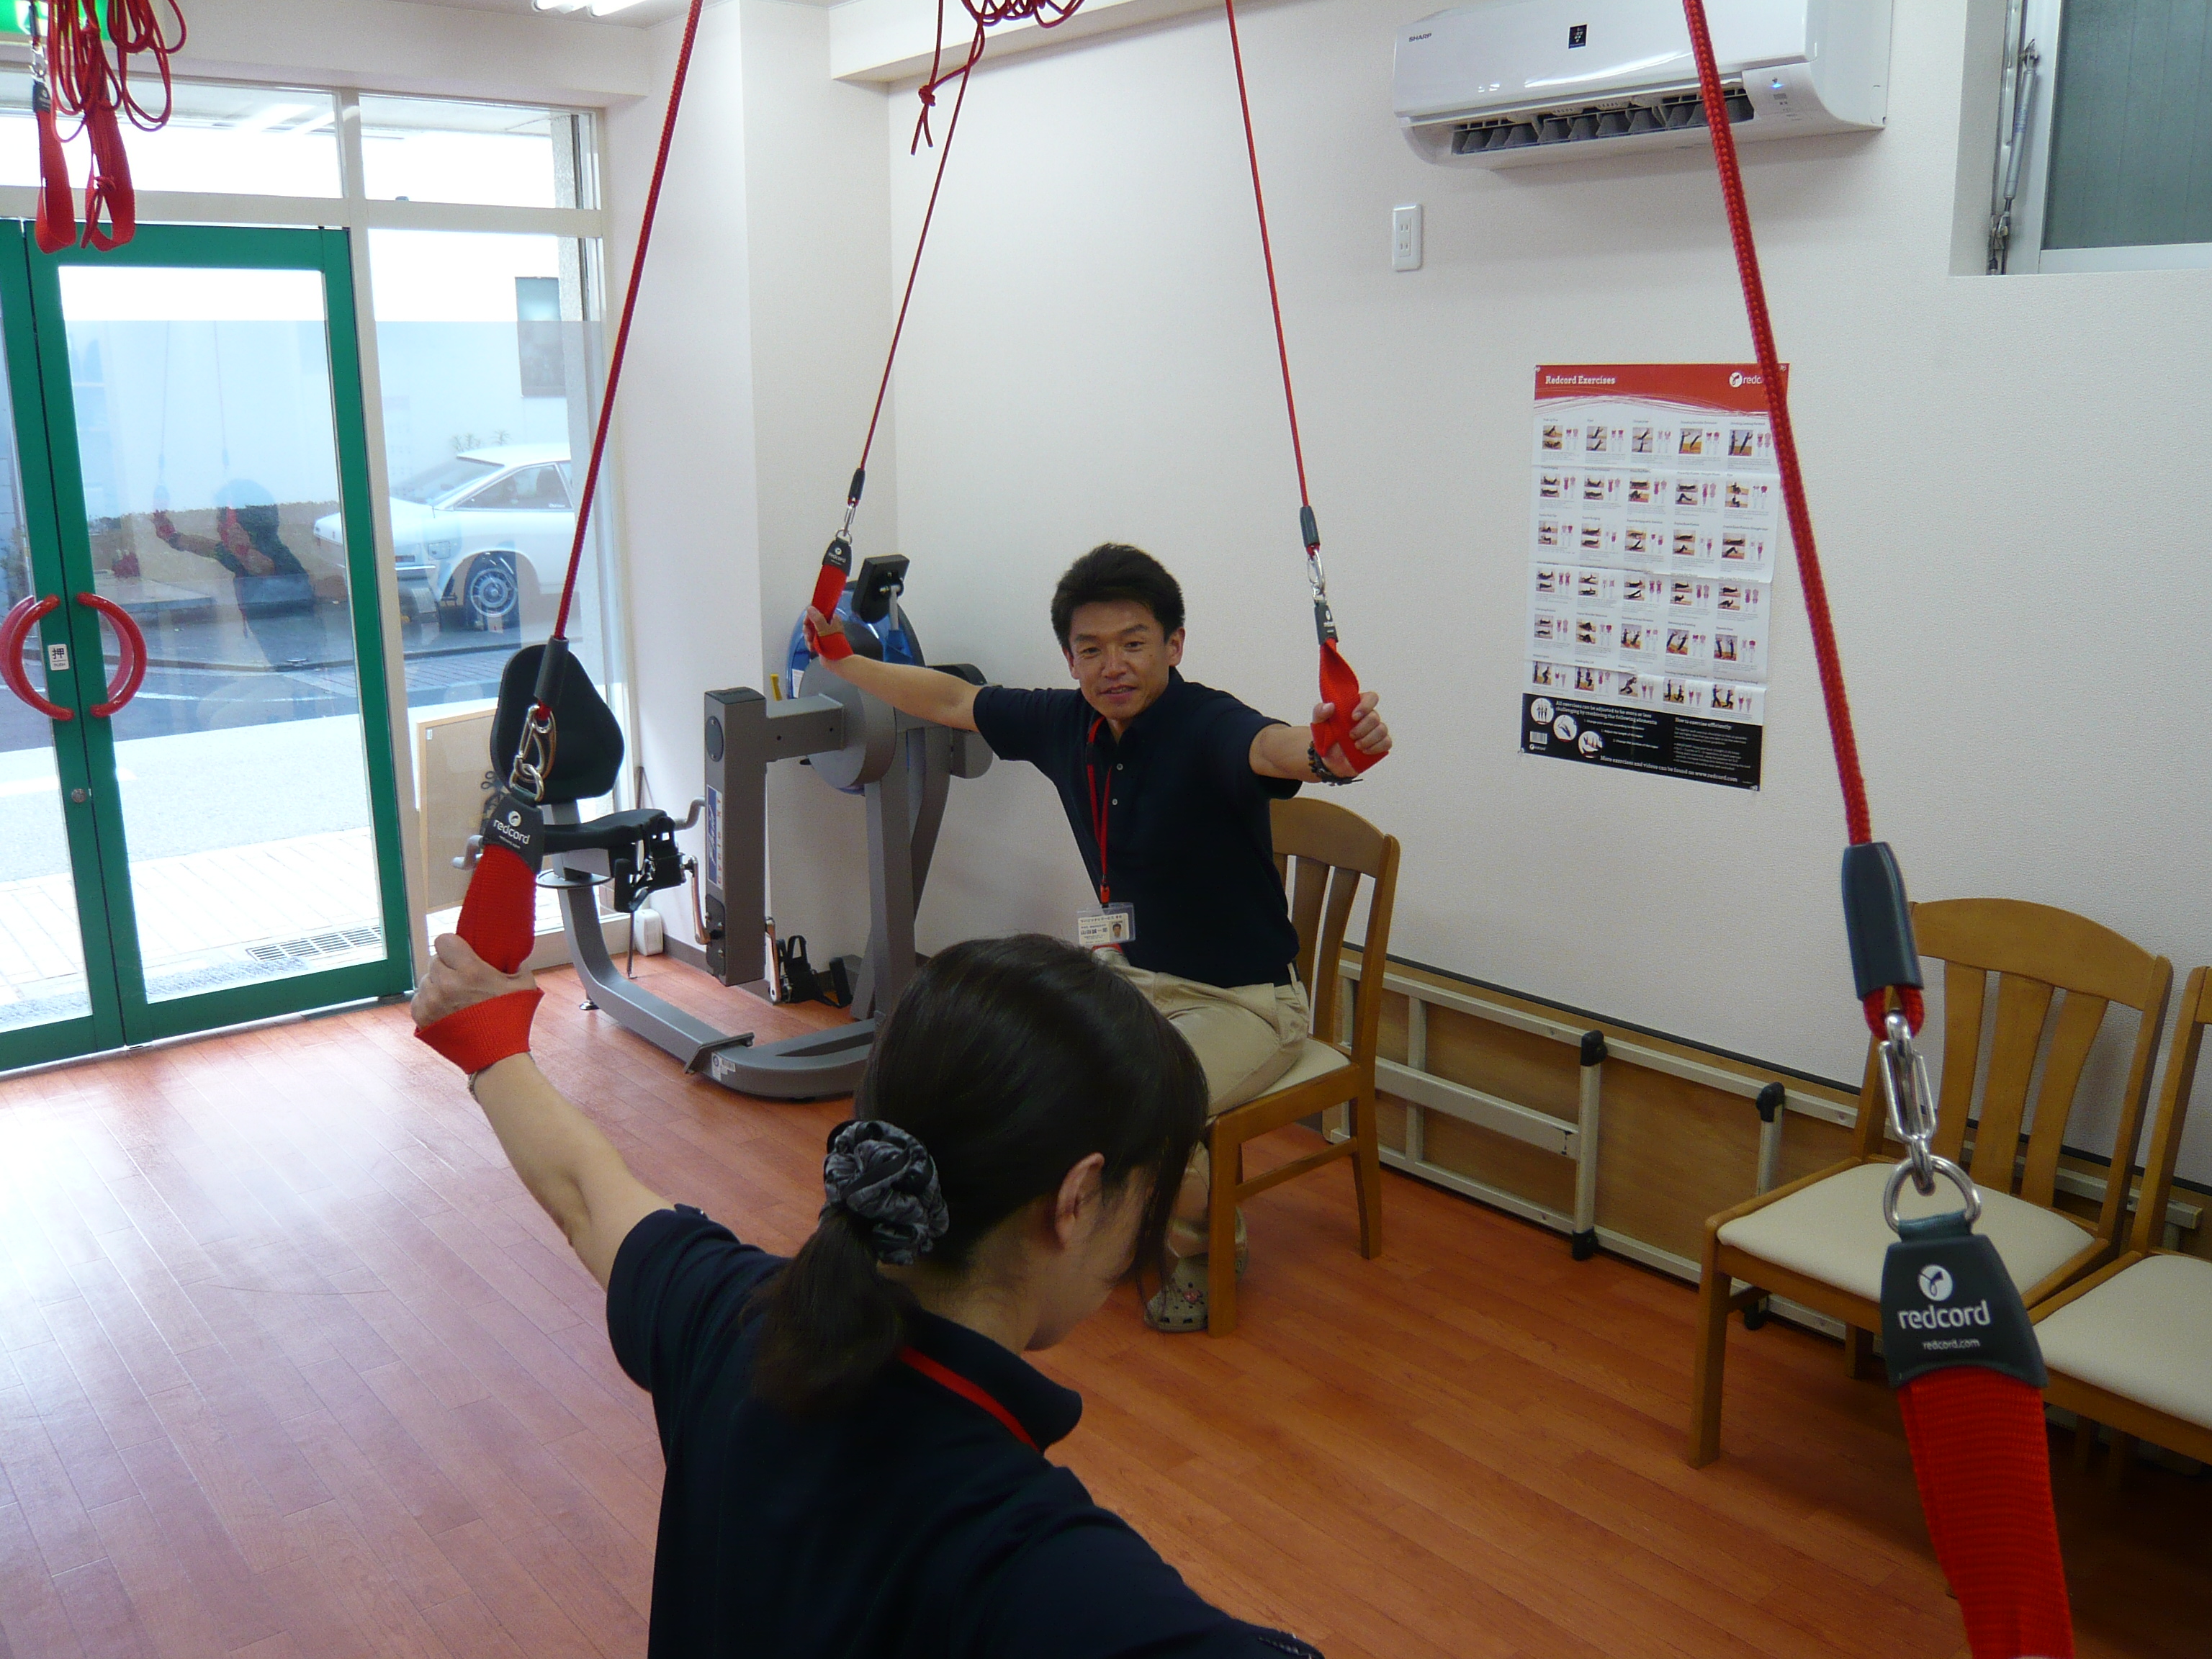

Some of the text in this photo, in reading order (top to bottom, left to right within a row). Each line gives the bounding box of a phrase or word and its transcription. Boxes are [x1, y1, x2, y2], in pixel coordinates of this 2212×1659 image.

[1408, 32, 1431, 42] SHARP
[1545, 375, 1615, 385] Redcord Exercises
[1743, 375, 1763, 385] redc
[52, 648, 64, 659] 押
[493, 819, 531, 845] redcord
[1897, 1299, 1991, 1329] redcord
[1922, 1337, 1980, 1351] redcord.com
